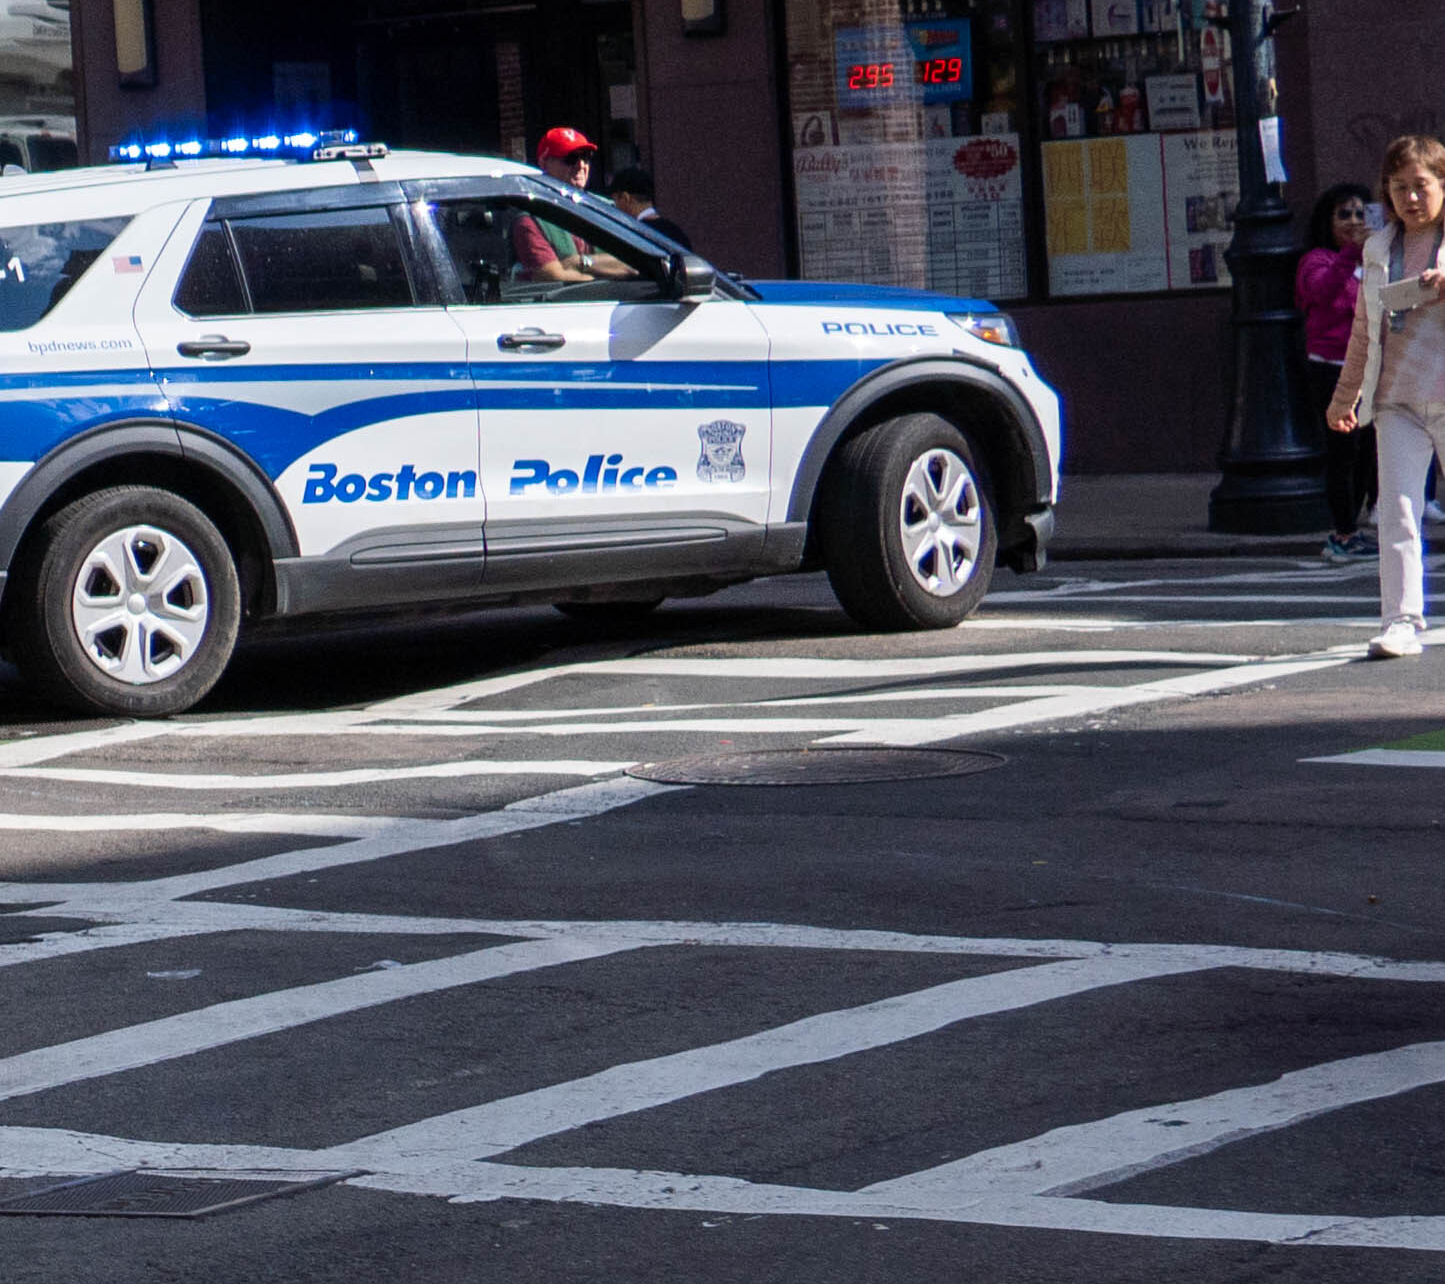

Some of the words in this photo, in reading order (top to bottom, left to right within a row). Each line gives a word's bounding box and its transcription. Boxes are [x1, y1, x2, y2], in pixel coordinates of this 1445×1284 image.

[847, 63, 895, 90] 295
[923, 57, 962, 84] 129
[821, 320, 941, 338] POLICE
[27, 335, 134, 356] bpdnews.com
[301, 462, 478, 507] Boston
[508, 452, 678, 498] Police
